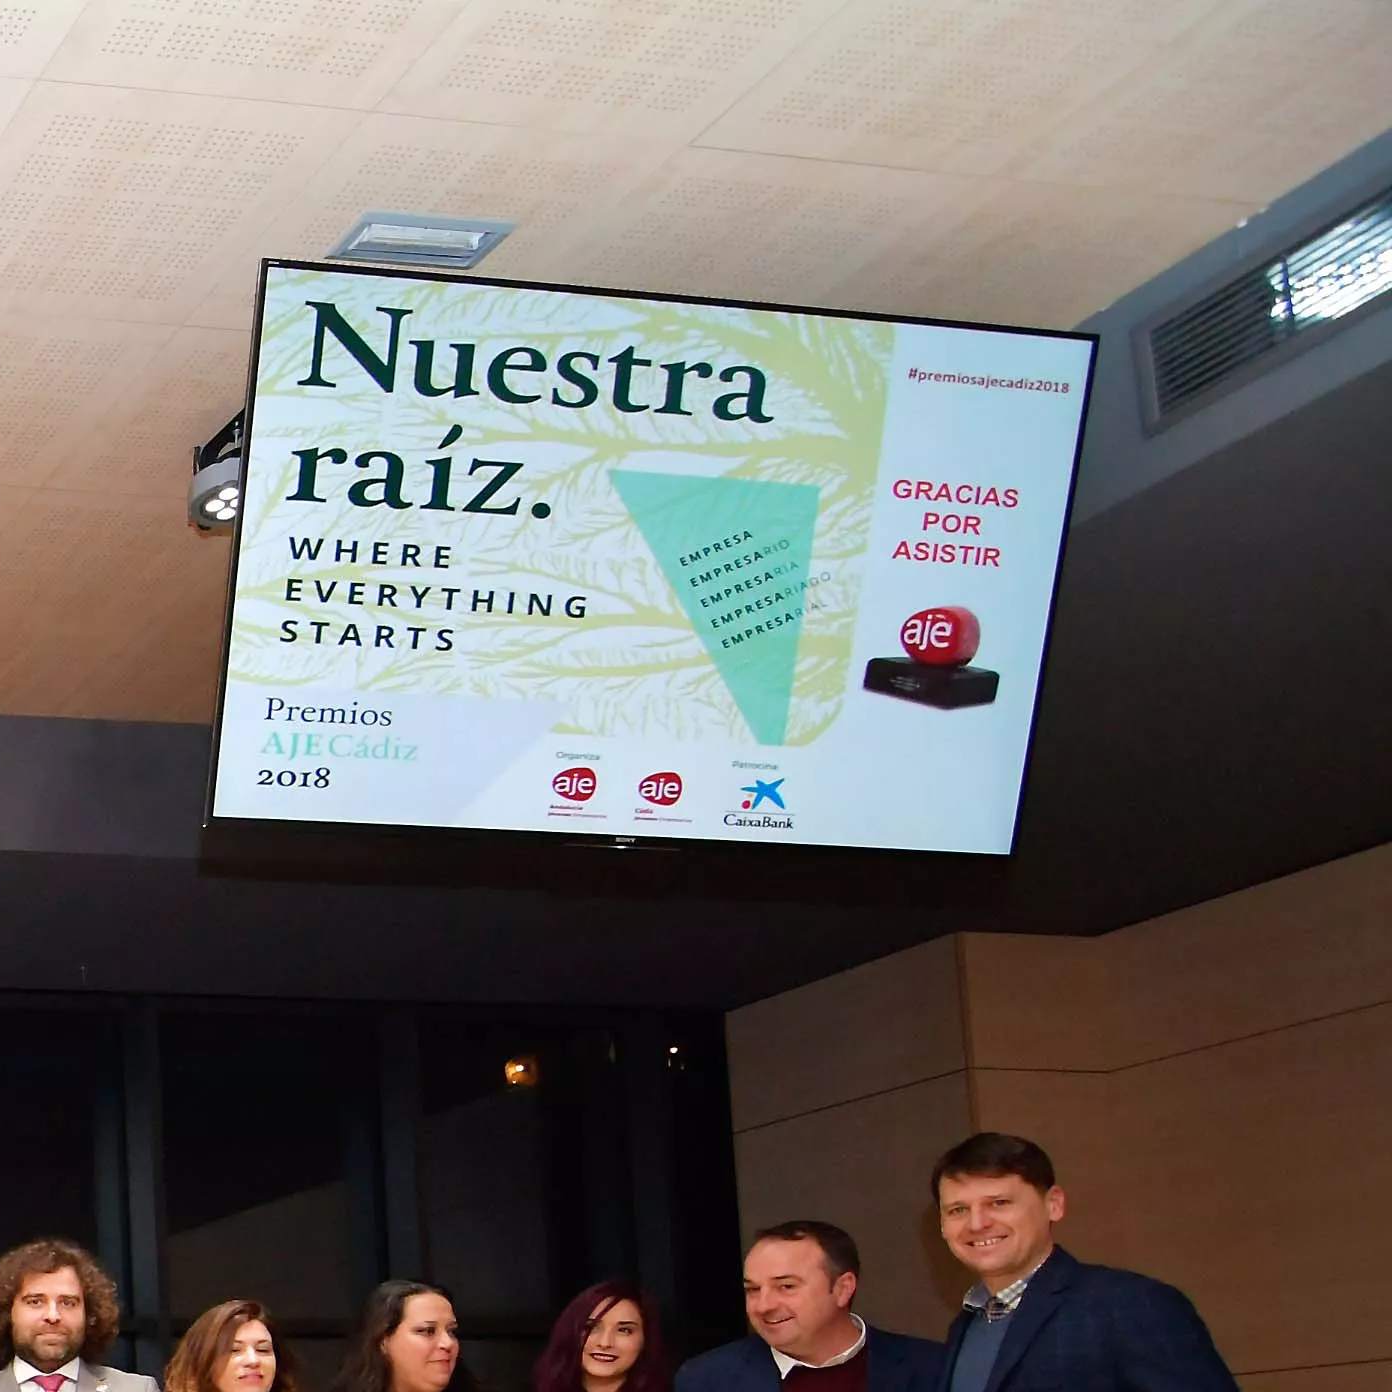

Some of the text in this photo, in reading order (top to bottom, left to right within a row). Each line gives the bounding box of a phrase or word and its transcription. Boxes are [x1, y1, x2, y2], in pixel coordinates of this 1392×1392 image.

[297, 301, 774, 423] Nuestra
[908, 367, 1070, 394] #premiosajecadiz2018
[285, 424, 551, 519] raíz.
[892, 479, 1018, 508] GRACIAS
[922, 512, 981, 535] POR
[289, 537, 451, 568] WHERE
[679, 530, 753, 566] EMPRESA
[690, 539, 790, 587] EMPRESARIO
[892, 540, 1000, 567] ASISTIR
[285, 579, 586, 618] EVERYTHING
[700, 561, 799, 608] EMPRESARIA
[711, 571, 831, 628] EMPRESARIADO
[279, 620, 454, 651] STARTS
[904, 614, 952, 650] aje
[264, 697, 392, 726] Premios
[257, 767, 330, 789] 2018
[554, 774, 594, 795] aje
[640, 778, 680, 800] aje
[724, 814, 794, 829] CaixaBank
